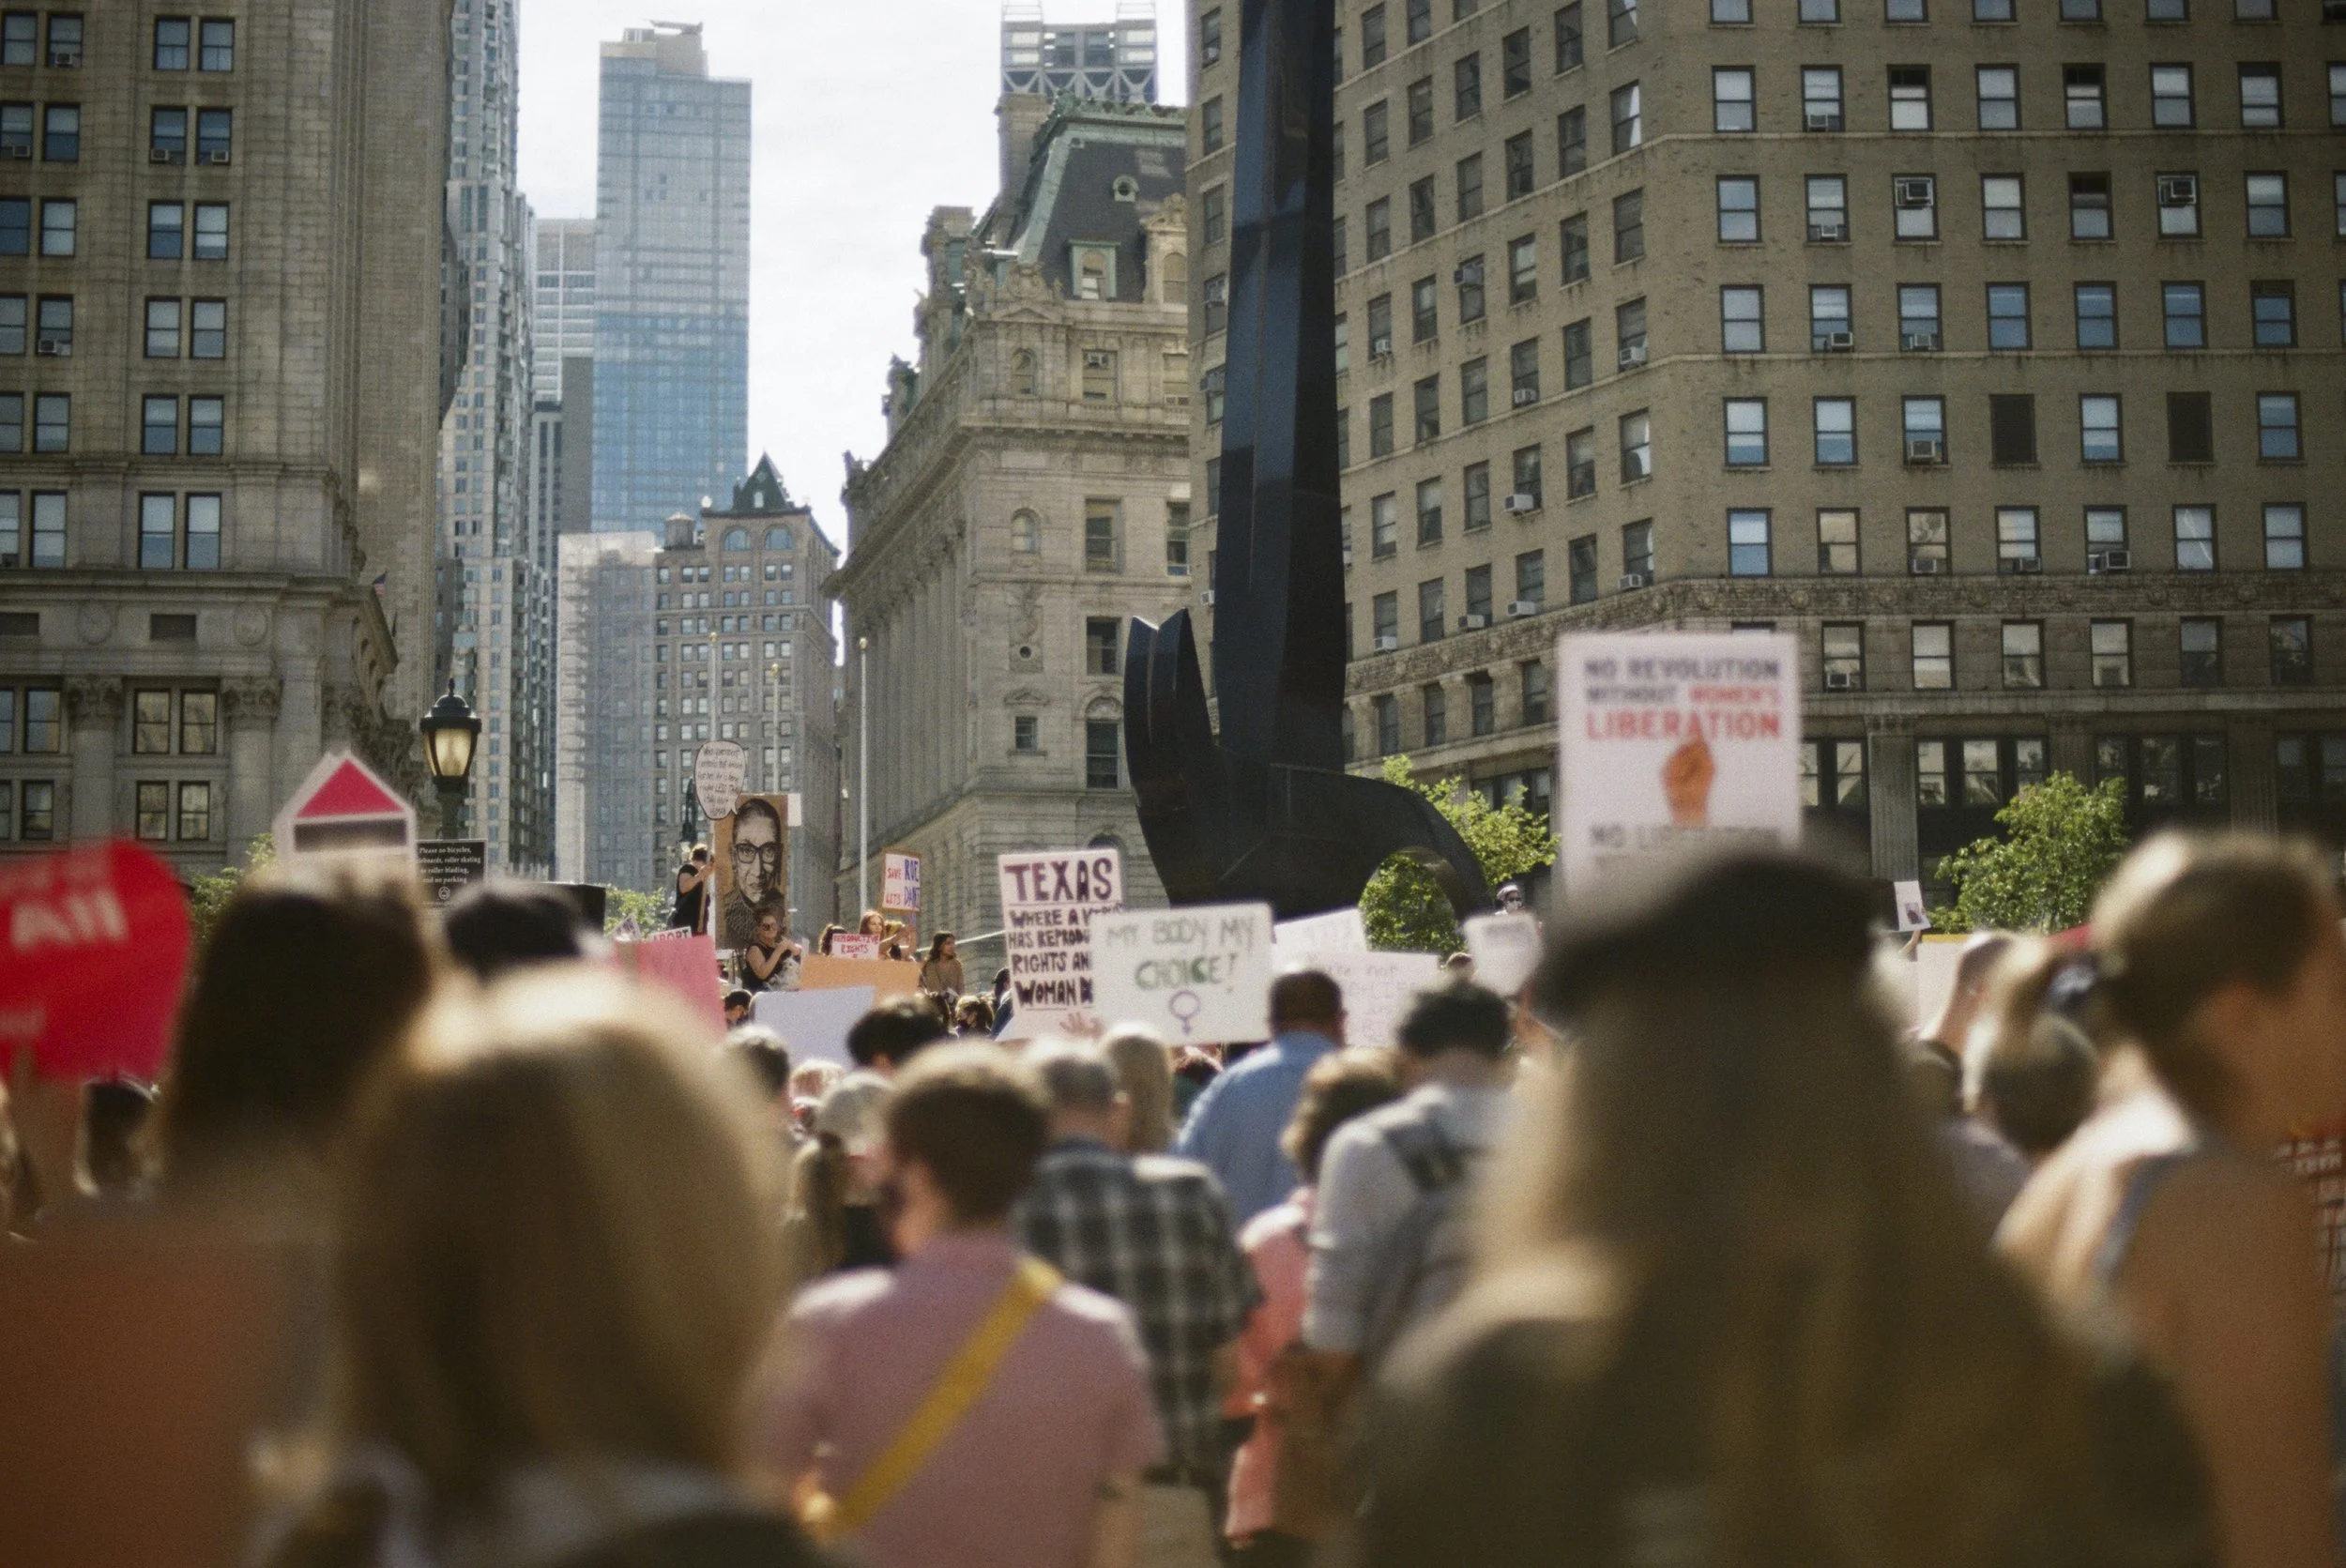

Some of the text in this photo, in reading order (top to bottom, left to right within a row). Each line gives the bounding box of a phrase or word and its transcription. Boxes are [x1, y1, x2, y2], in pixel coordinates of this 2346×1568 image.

[1584, 659, 1780, 679] NO REVOLUTION
[1585, 685, 1781, 704] WITHOUT WOMEN'S
[1586, 710, 1781, 740] LIBERATION
[447, 846, 472, 855] bicycles,
[443, 875, 467, 885] parking
[1003, 857, 1114, 901] TEXAS
[1009, 909, 1063, 929] WHERE
[1067, 908, 1078, 927] A
[1008, 930, 1034, 950] HAS
[1151, 917, 1210, 949] BODY
[1220, 916, 1257, 955] MY
[1012, 951, 1068, 975] RIGHTS
[1014, 979, 1078, 1010] WOMAN
